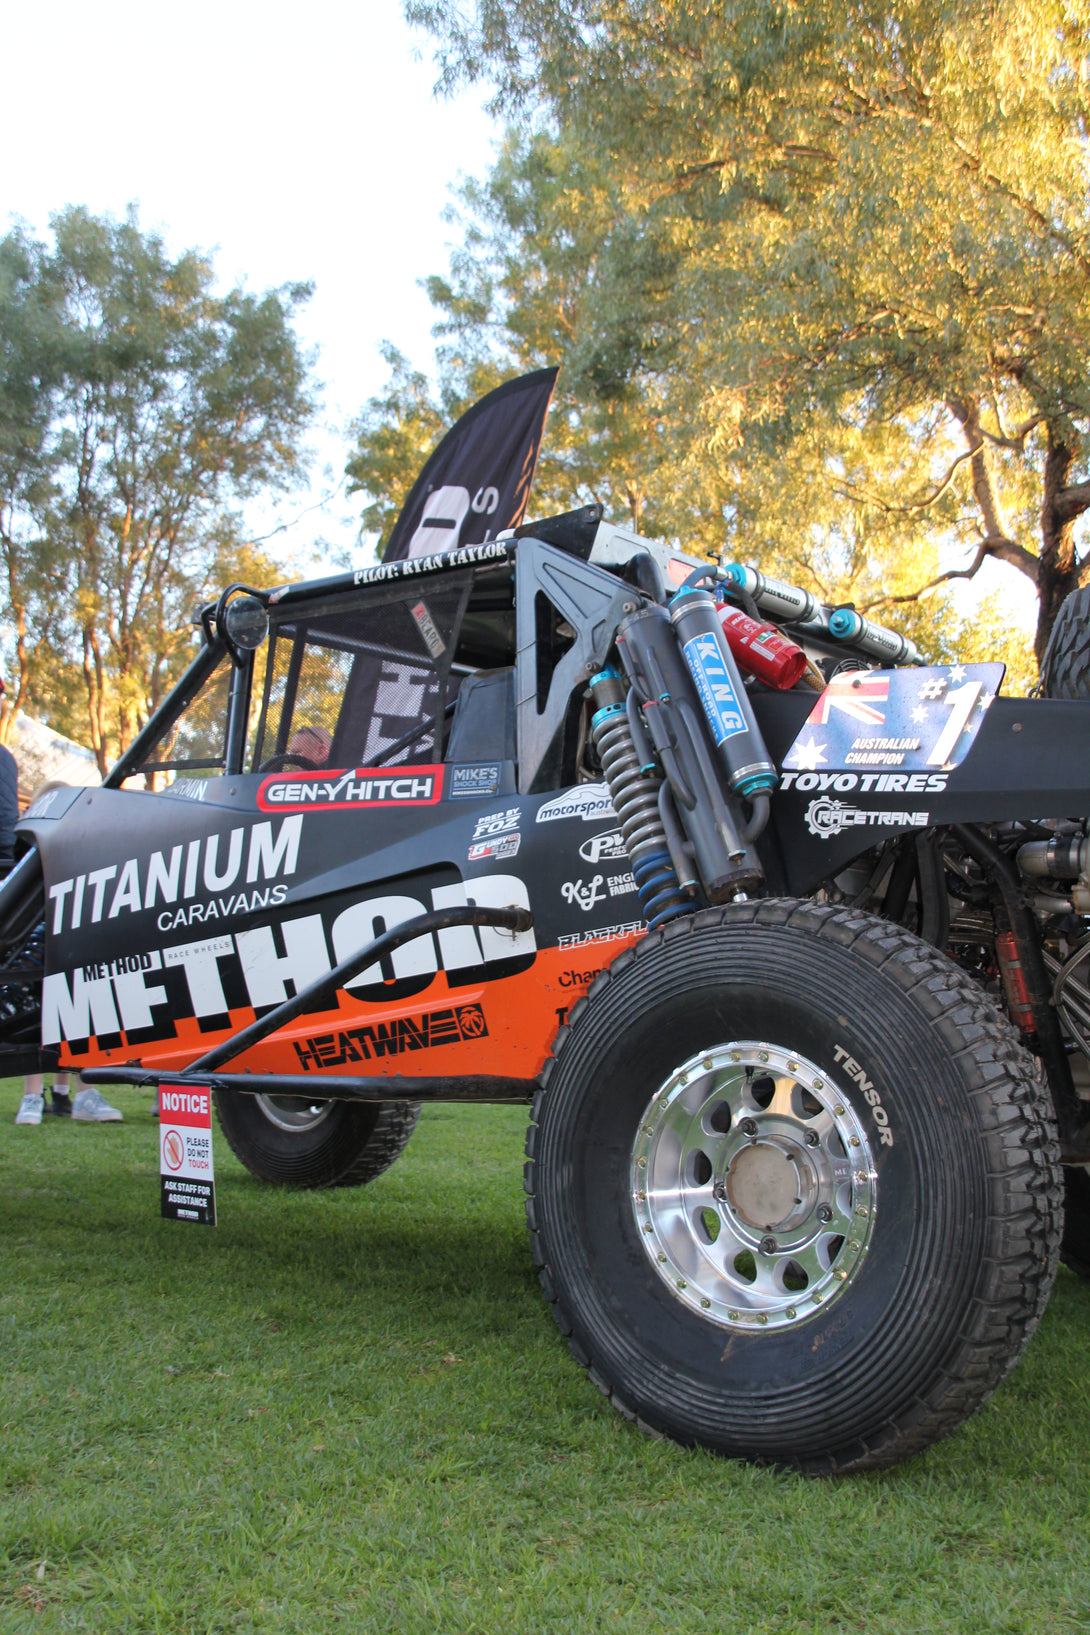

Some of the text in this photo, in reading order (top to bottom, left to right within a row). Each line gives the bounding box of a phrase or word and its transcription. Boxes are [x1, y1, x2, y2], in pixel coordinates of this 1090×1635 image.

[354, 542, 507, 585] PILOT: RYAN TAYLOR
[696, 642, 743, 730] KING
[850, 737, 921, 751] AUSTRALIAN
[844, 752, 906, 765] CHAMPION
[453, 767, 498, 781] MIKE'S
[780, 772, 949, 792] TOYO TIRES
[267, 769, 433, 802] GEN-Y HITCH
[478, 807, 520, 824] PREP BY
[817, 810, 930, 826] RACETRANS
[472, 815, 521, 838] FOZ
[49, 813, 304, 936] TITANIUM
[561, 874, 607, 911] K&L
[157, 884, 289, 932] CARAVANS
[168, 941, 231, 960] RACE WHEELS
[41, 874, 538, 1056] METHOD
[82, 951, 152, 983] METHOD
[292, 1009, 463, 1072] HEATWAVE
[161, 1092, 209, 1114] NOTICE
[833, 1044, 894, 1148] TENSOR
[186, 1136, 210, 1148] PLEASE
[187, 1148, 209, 1159] DO NOT
[188, 1158, 210, 1170] TOUCH
[164, 1180, 211, 1196] ASK STAFF FOR
[168, 1193, 208, 1208] ASSISTANCE
